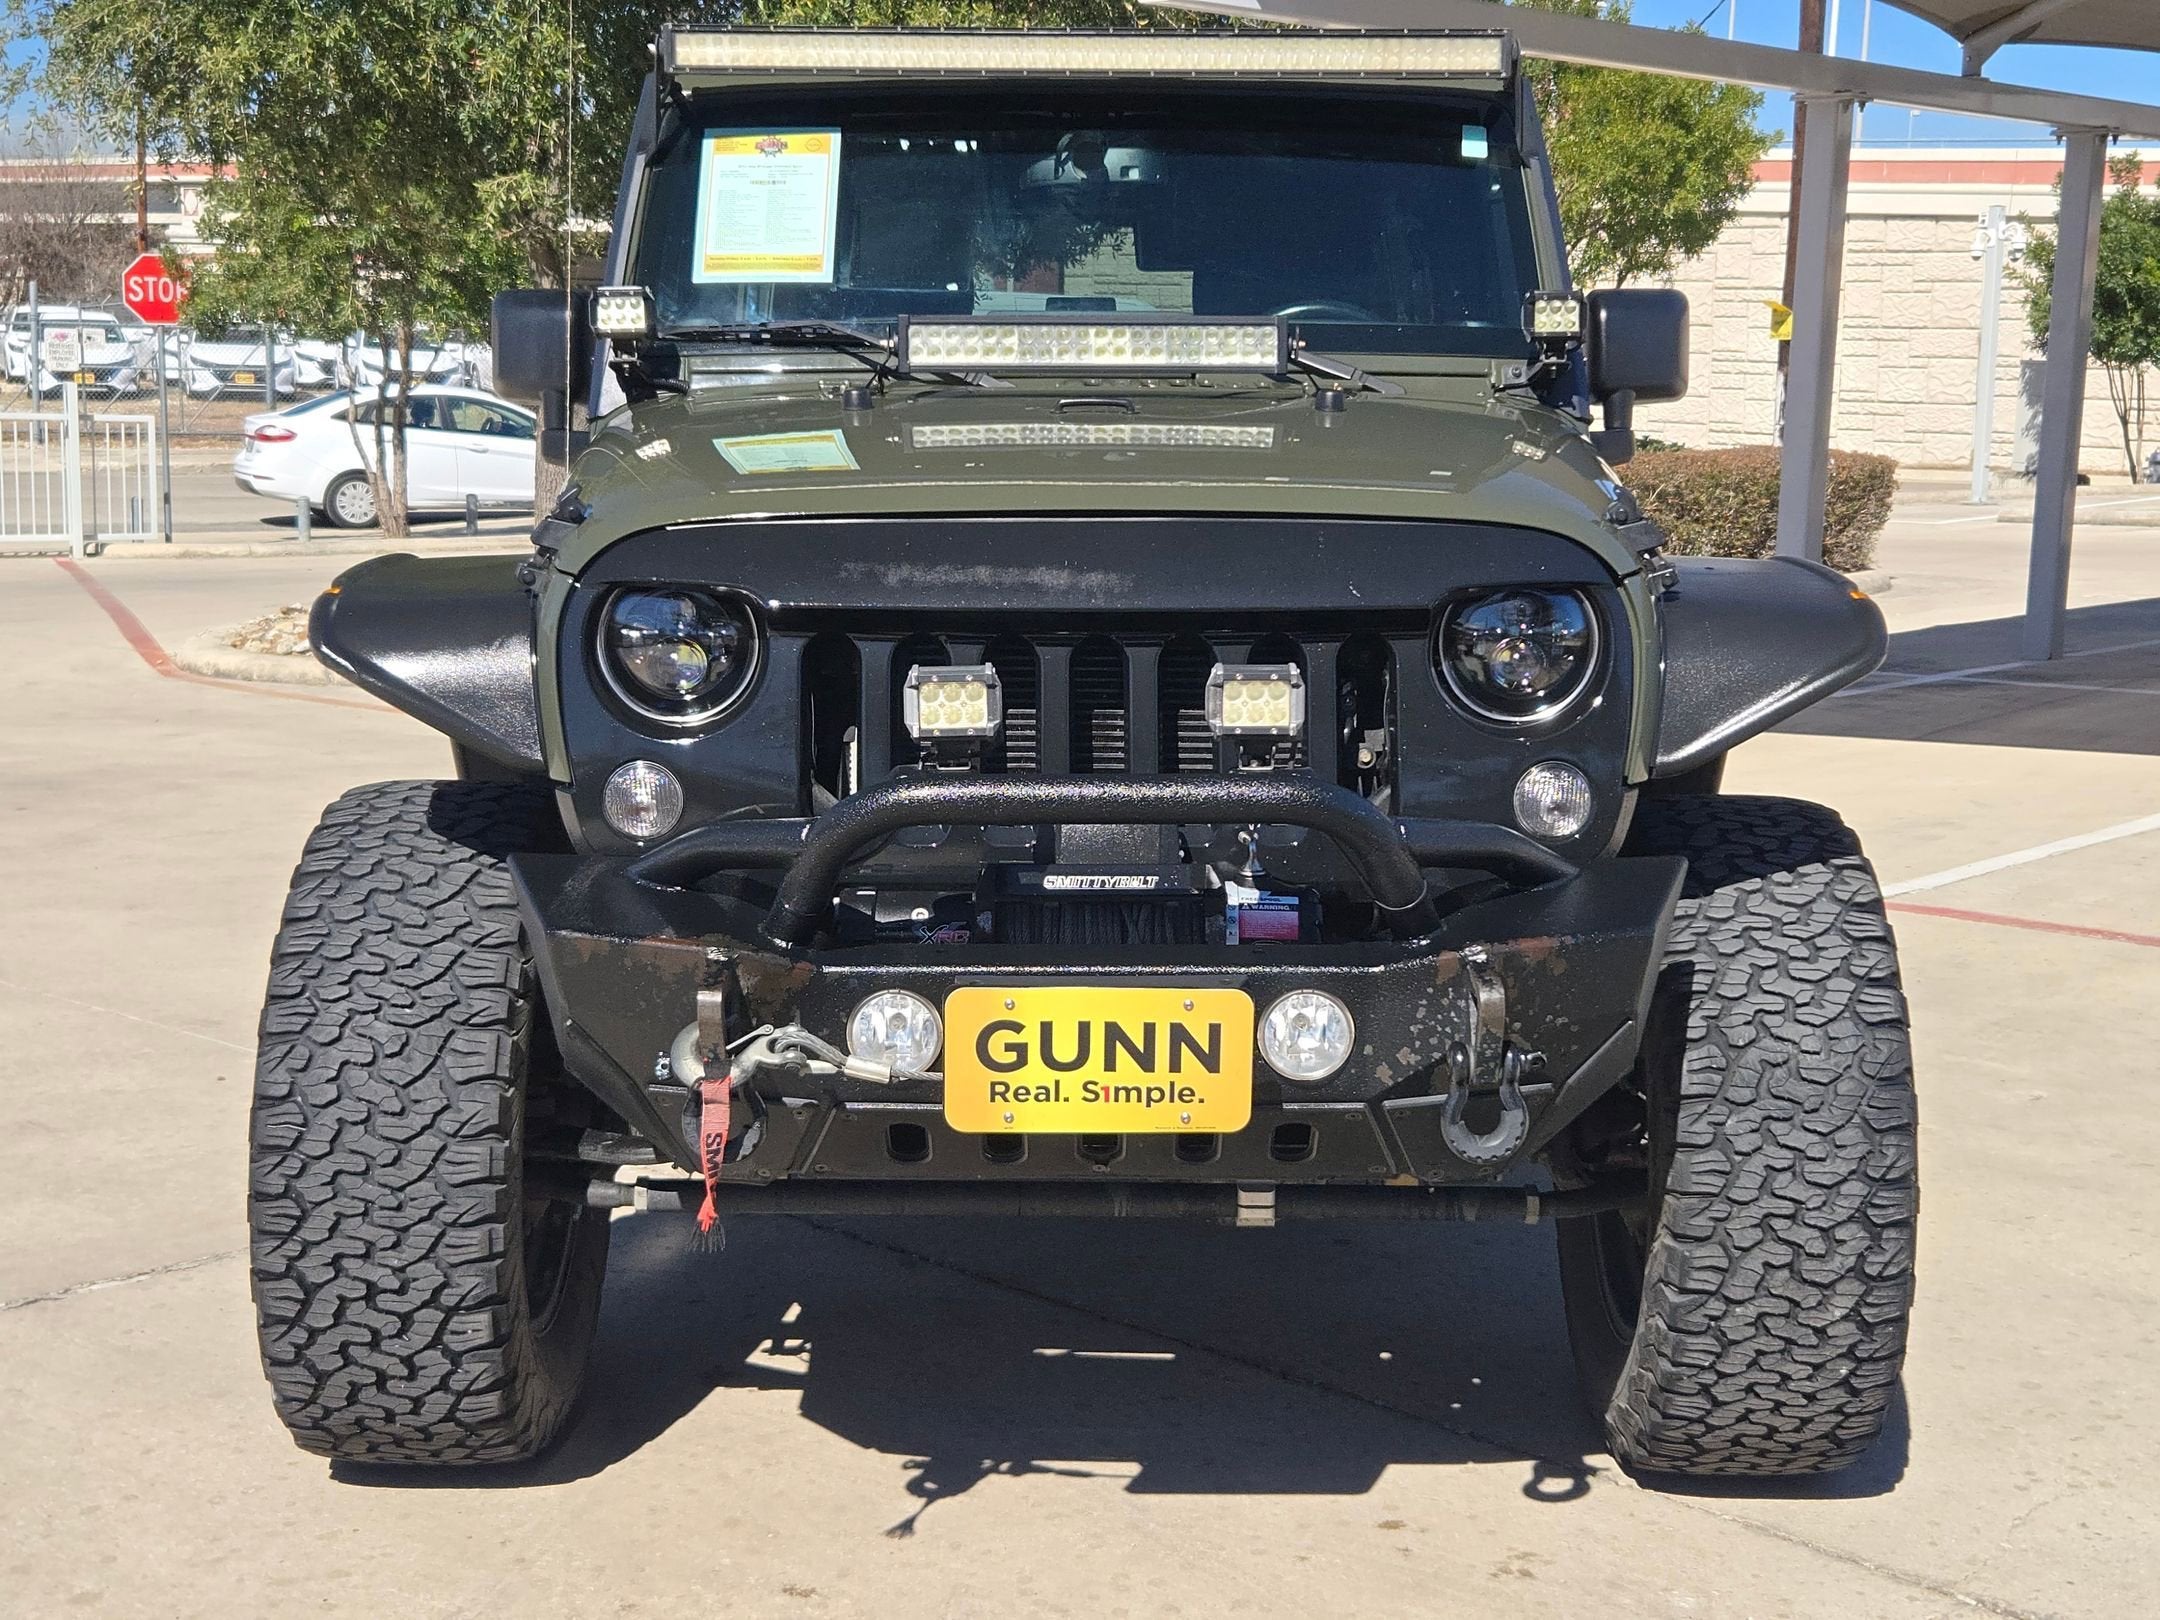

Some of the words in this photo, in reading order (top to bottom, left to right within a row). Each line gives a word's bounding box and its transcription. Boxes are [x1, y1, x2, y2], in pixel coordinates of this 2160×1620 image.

[1043, 875, 1159, 890] SMITTYBILT
[975, 1019, 1222, 1074] GUNN
[989, 1080, 1070, 1103] Real.
